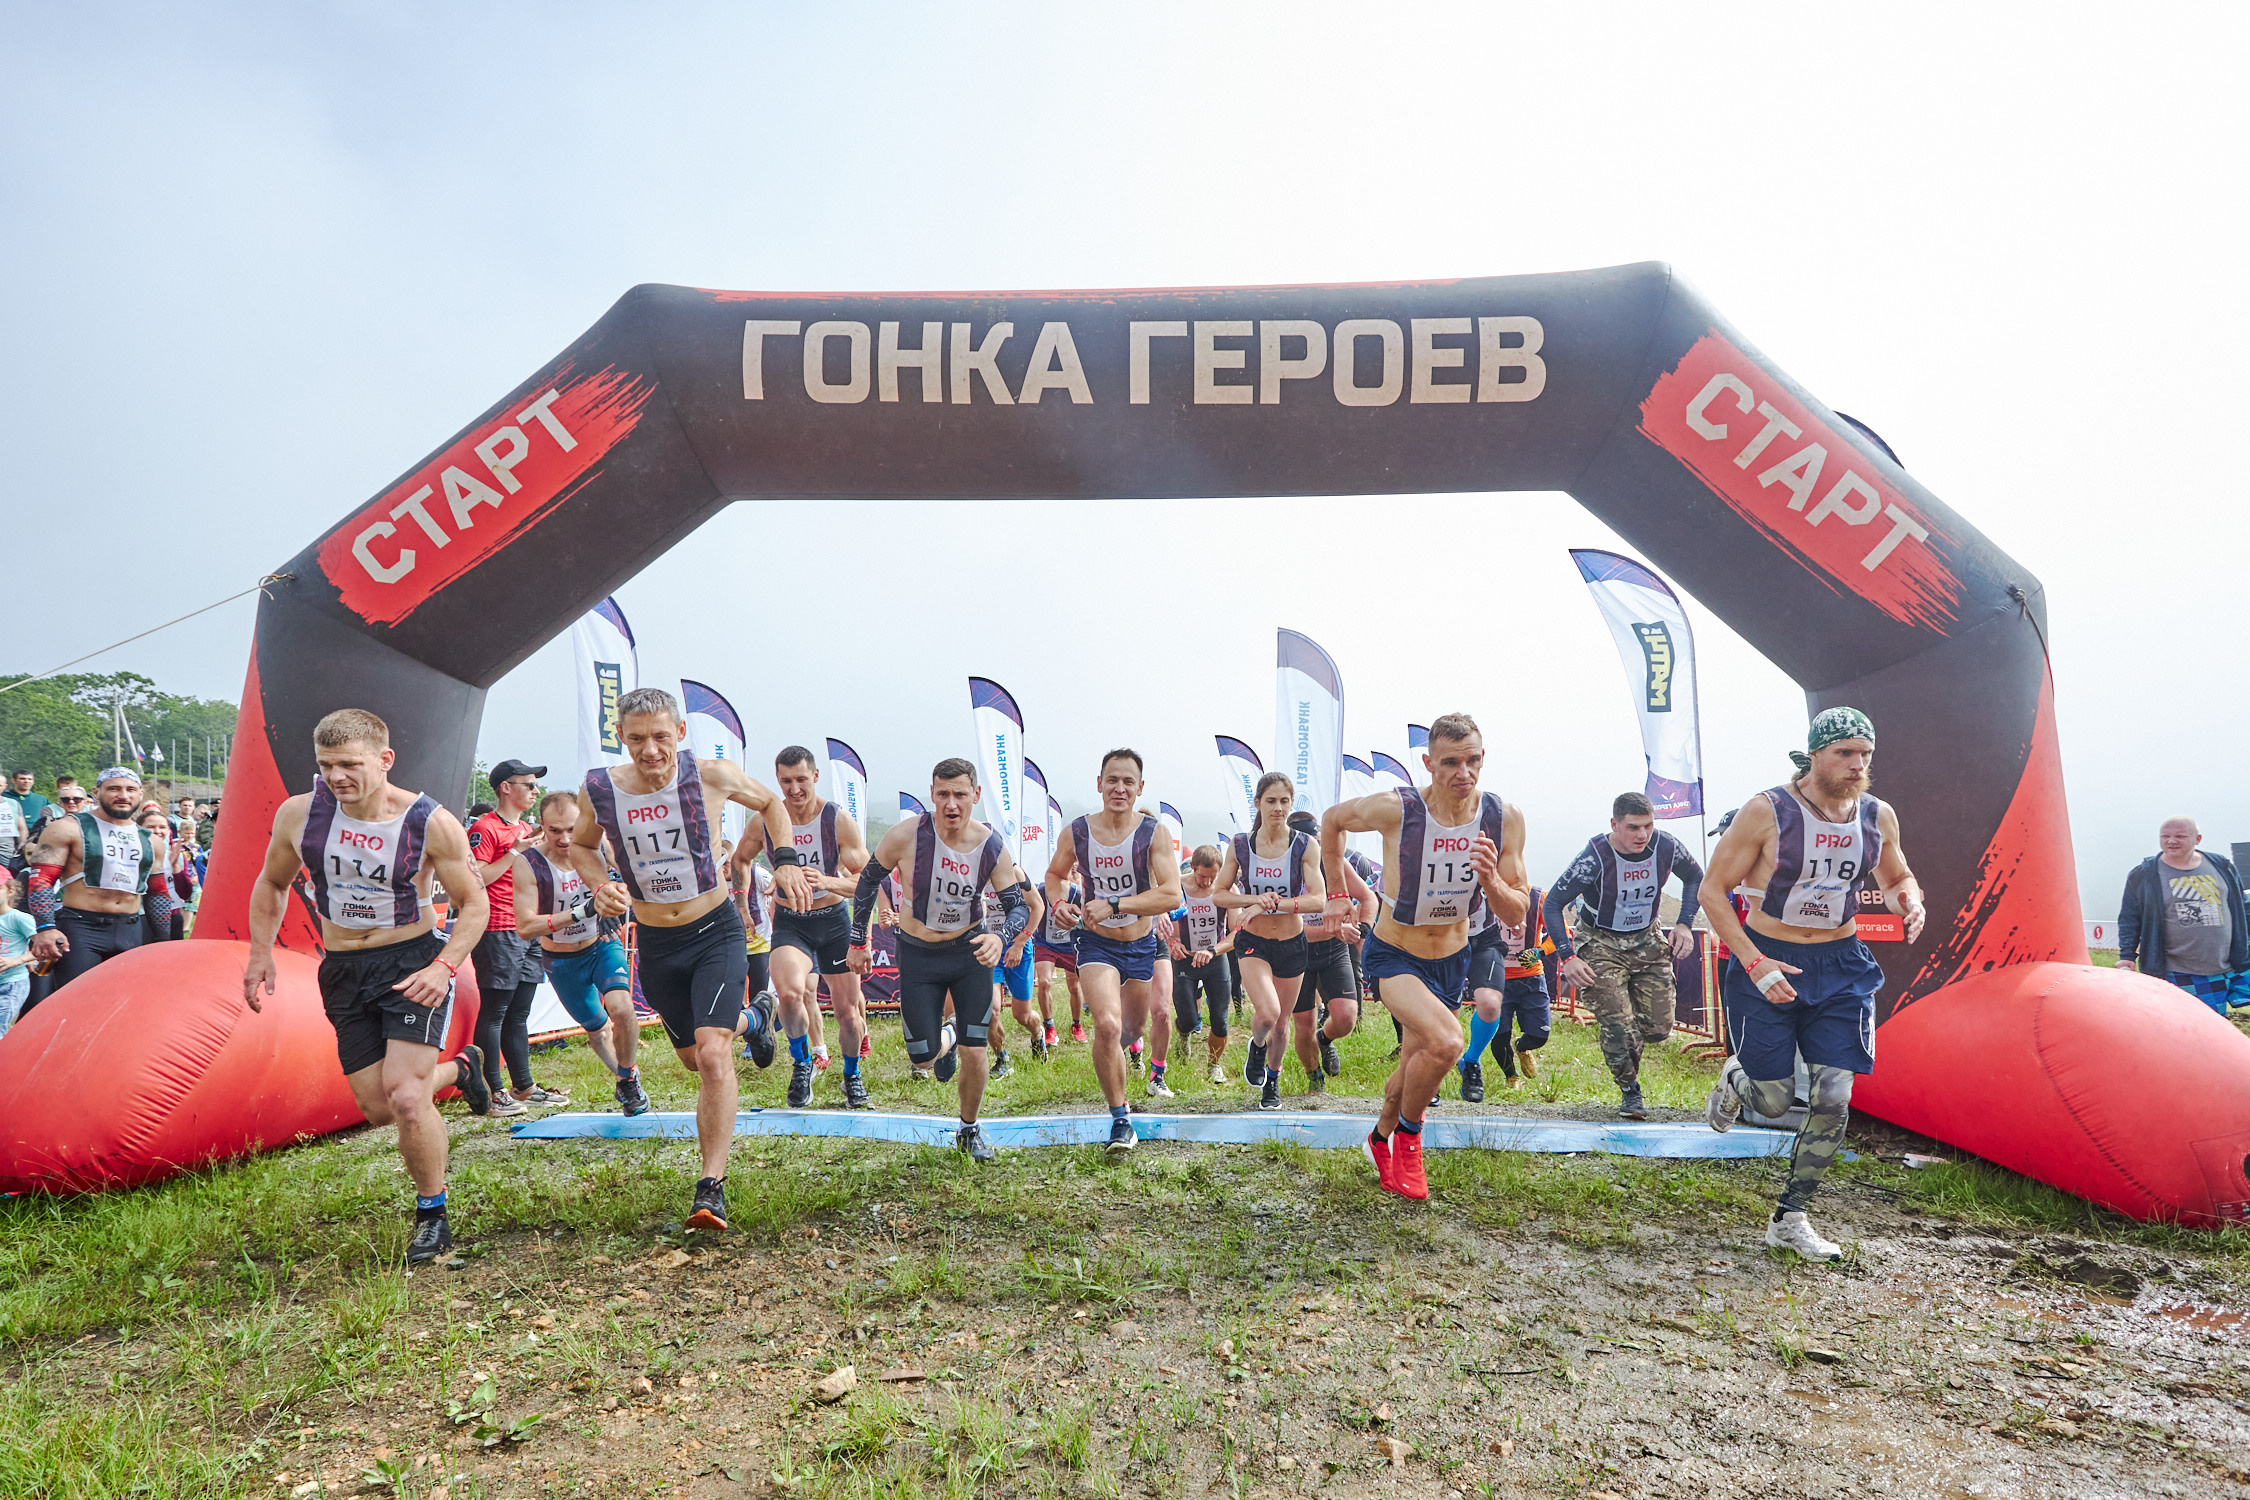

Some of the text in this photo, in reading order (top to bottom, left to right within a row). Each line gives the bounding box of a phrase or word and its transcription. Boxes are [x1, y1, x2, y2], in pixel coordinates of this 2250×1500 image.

[741, 315, 1546, 407] ГОНКА ГЕРОЕВ
[1685, 373, 1930, 572] СТАРТ
[351, 388, 578, 584] СТАРТ
[626, 804, 669, 825] PRO
[108, 830, 135, 841] AGE
[339, 829, 384, 851] PRO
[627, 828, 681, 855] 117
[1815, 833, 1853, 848] PRO
[1432, 838, 1470, 852] PRO
[106, 845, 140, 861] 312
[330, 855, 387, 884] 114
[941, 856, 970, 875] PRO
[1095, 855, 1124, 869] PRO
[1809, 858, 1856, 881] 118
[1255, 866, 1282, 878] PRO
[1427, 862, 1474, 883] 113
[1623, 869, 1650, 882] PRO
[651, 876, 679, 886] ГОНКА
[936, 876, 976, 898] 106
[1094, 873, 1134, 892] 100
[651, 884, 682, 894] ГЕРОЕВ
[1621, 885, 1655, 901] 112
[343, 903, 374, 911] ГОНКА
[1191, 905, 1212, 914] PRO
[1799, 909, 1830, 918] ГЕРОЕВ
[1803, 902, 1829, 910] ГОНКА
[342, 911, 377, 920] ГЕРОЕВ
[1190, 917, 1216, 928] 135
[1856, 923, 1895, 932] erorace
